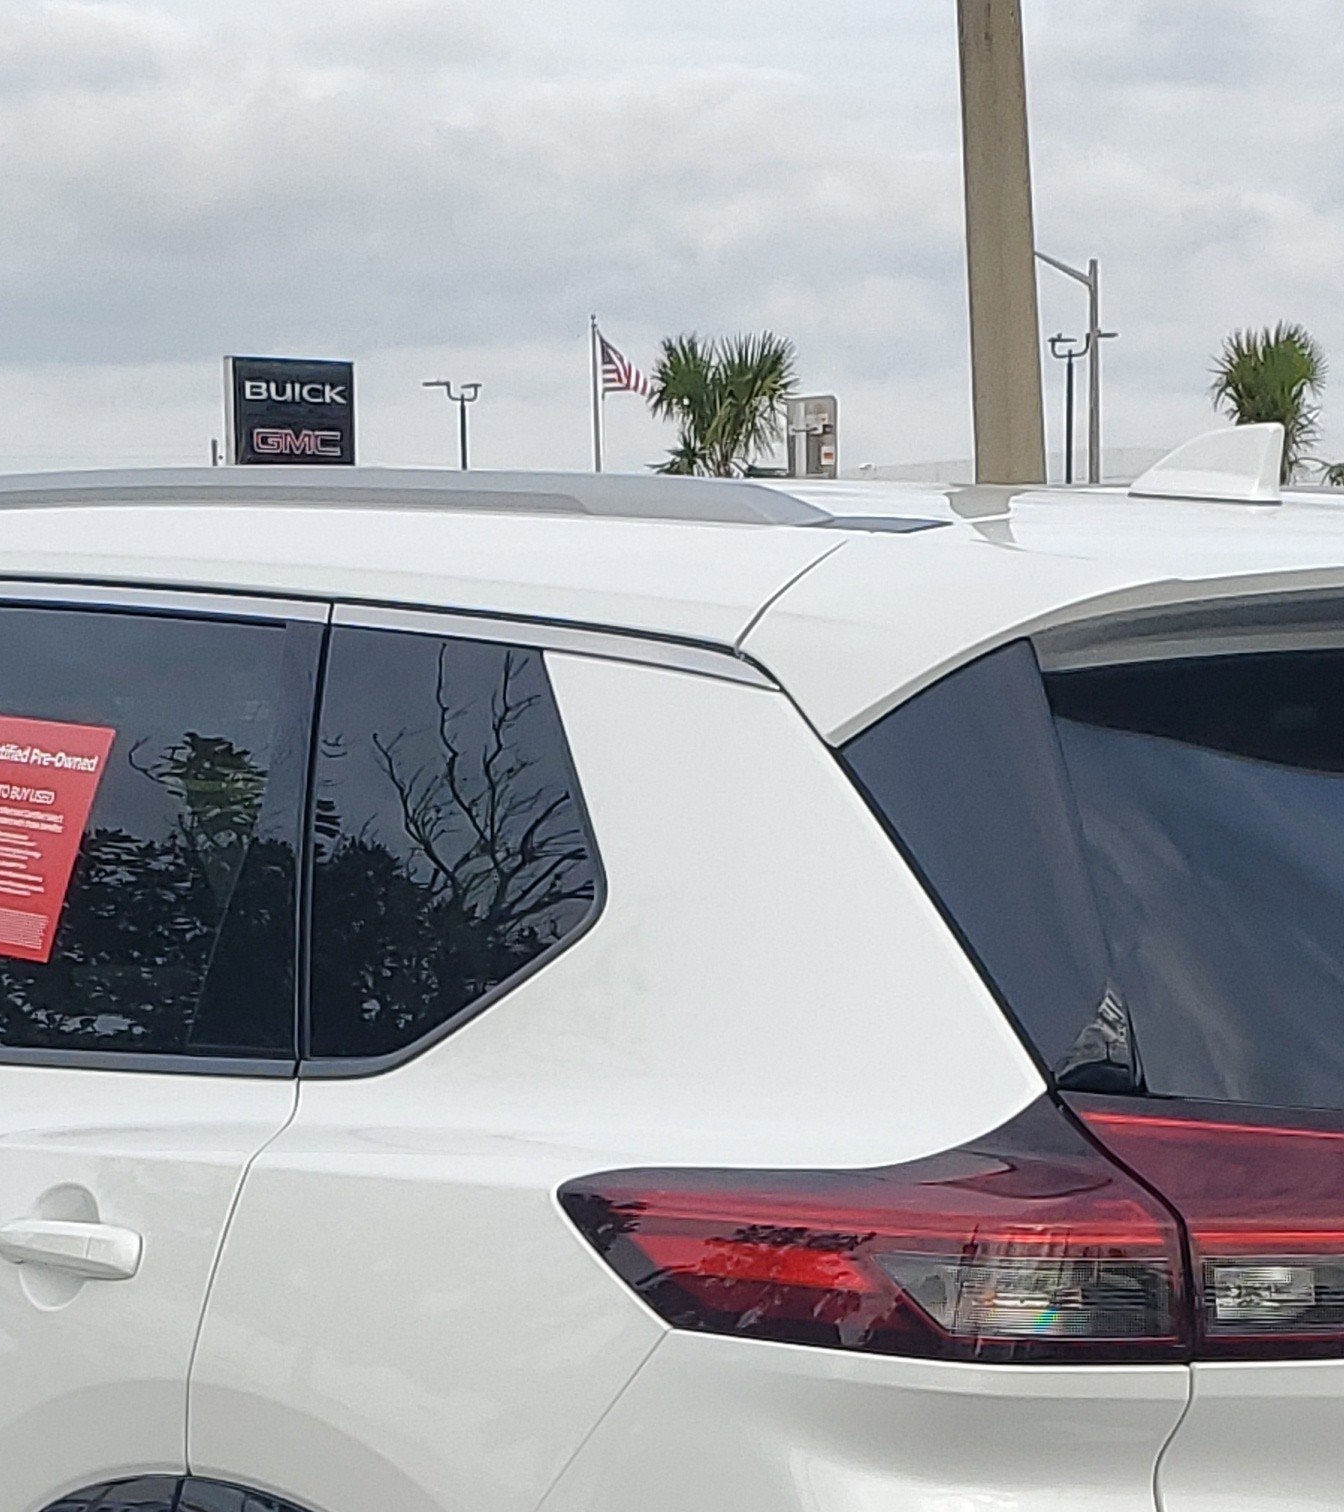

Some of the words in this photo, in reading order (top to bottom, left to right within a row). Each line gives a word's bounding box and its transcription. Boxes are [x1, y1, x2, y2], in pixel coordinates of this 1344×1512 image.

[244, 380, 347, 404] BUICK
[253, 428, 342, 456] GMC
[30, 748, 99, 772] Pre-Owned
[9, 786, 30, 801] BUY
